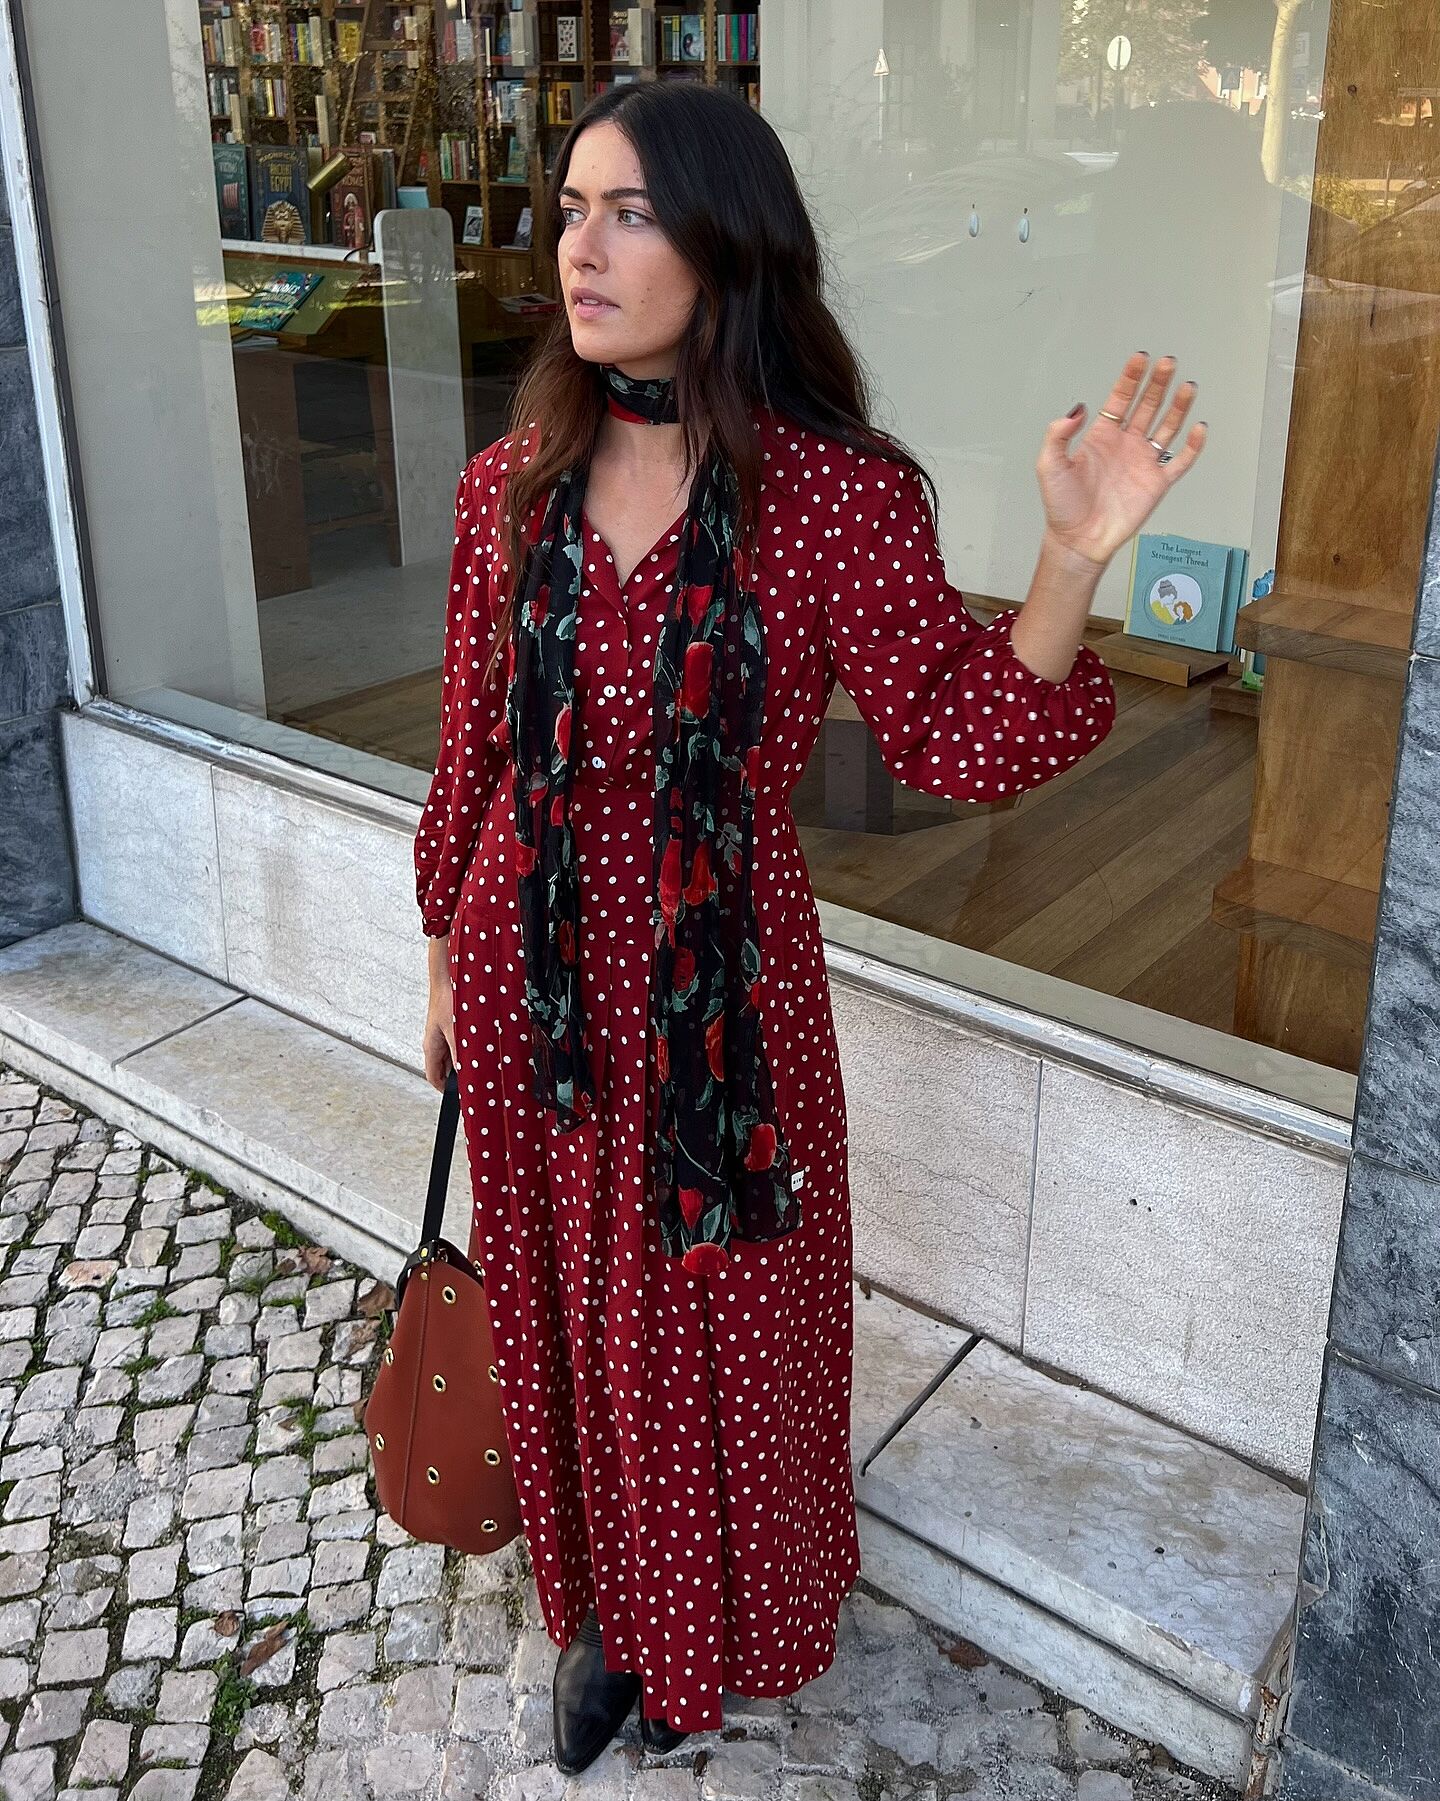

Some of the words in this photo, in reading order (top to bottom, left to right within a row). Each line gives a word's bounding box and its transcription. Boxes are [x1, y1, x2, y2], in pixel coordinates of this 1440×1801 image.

[270, 175, 292, 192] EGYPT
[1161, 542, 1175, 552] The
[1175, 545, 1202, 557] Longest
[1151, 550, 1183, 564] Strongest
[1185, 556, 1209, 568] Thread
